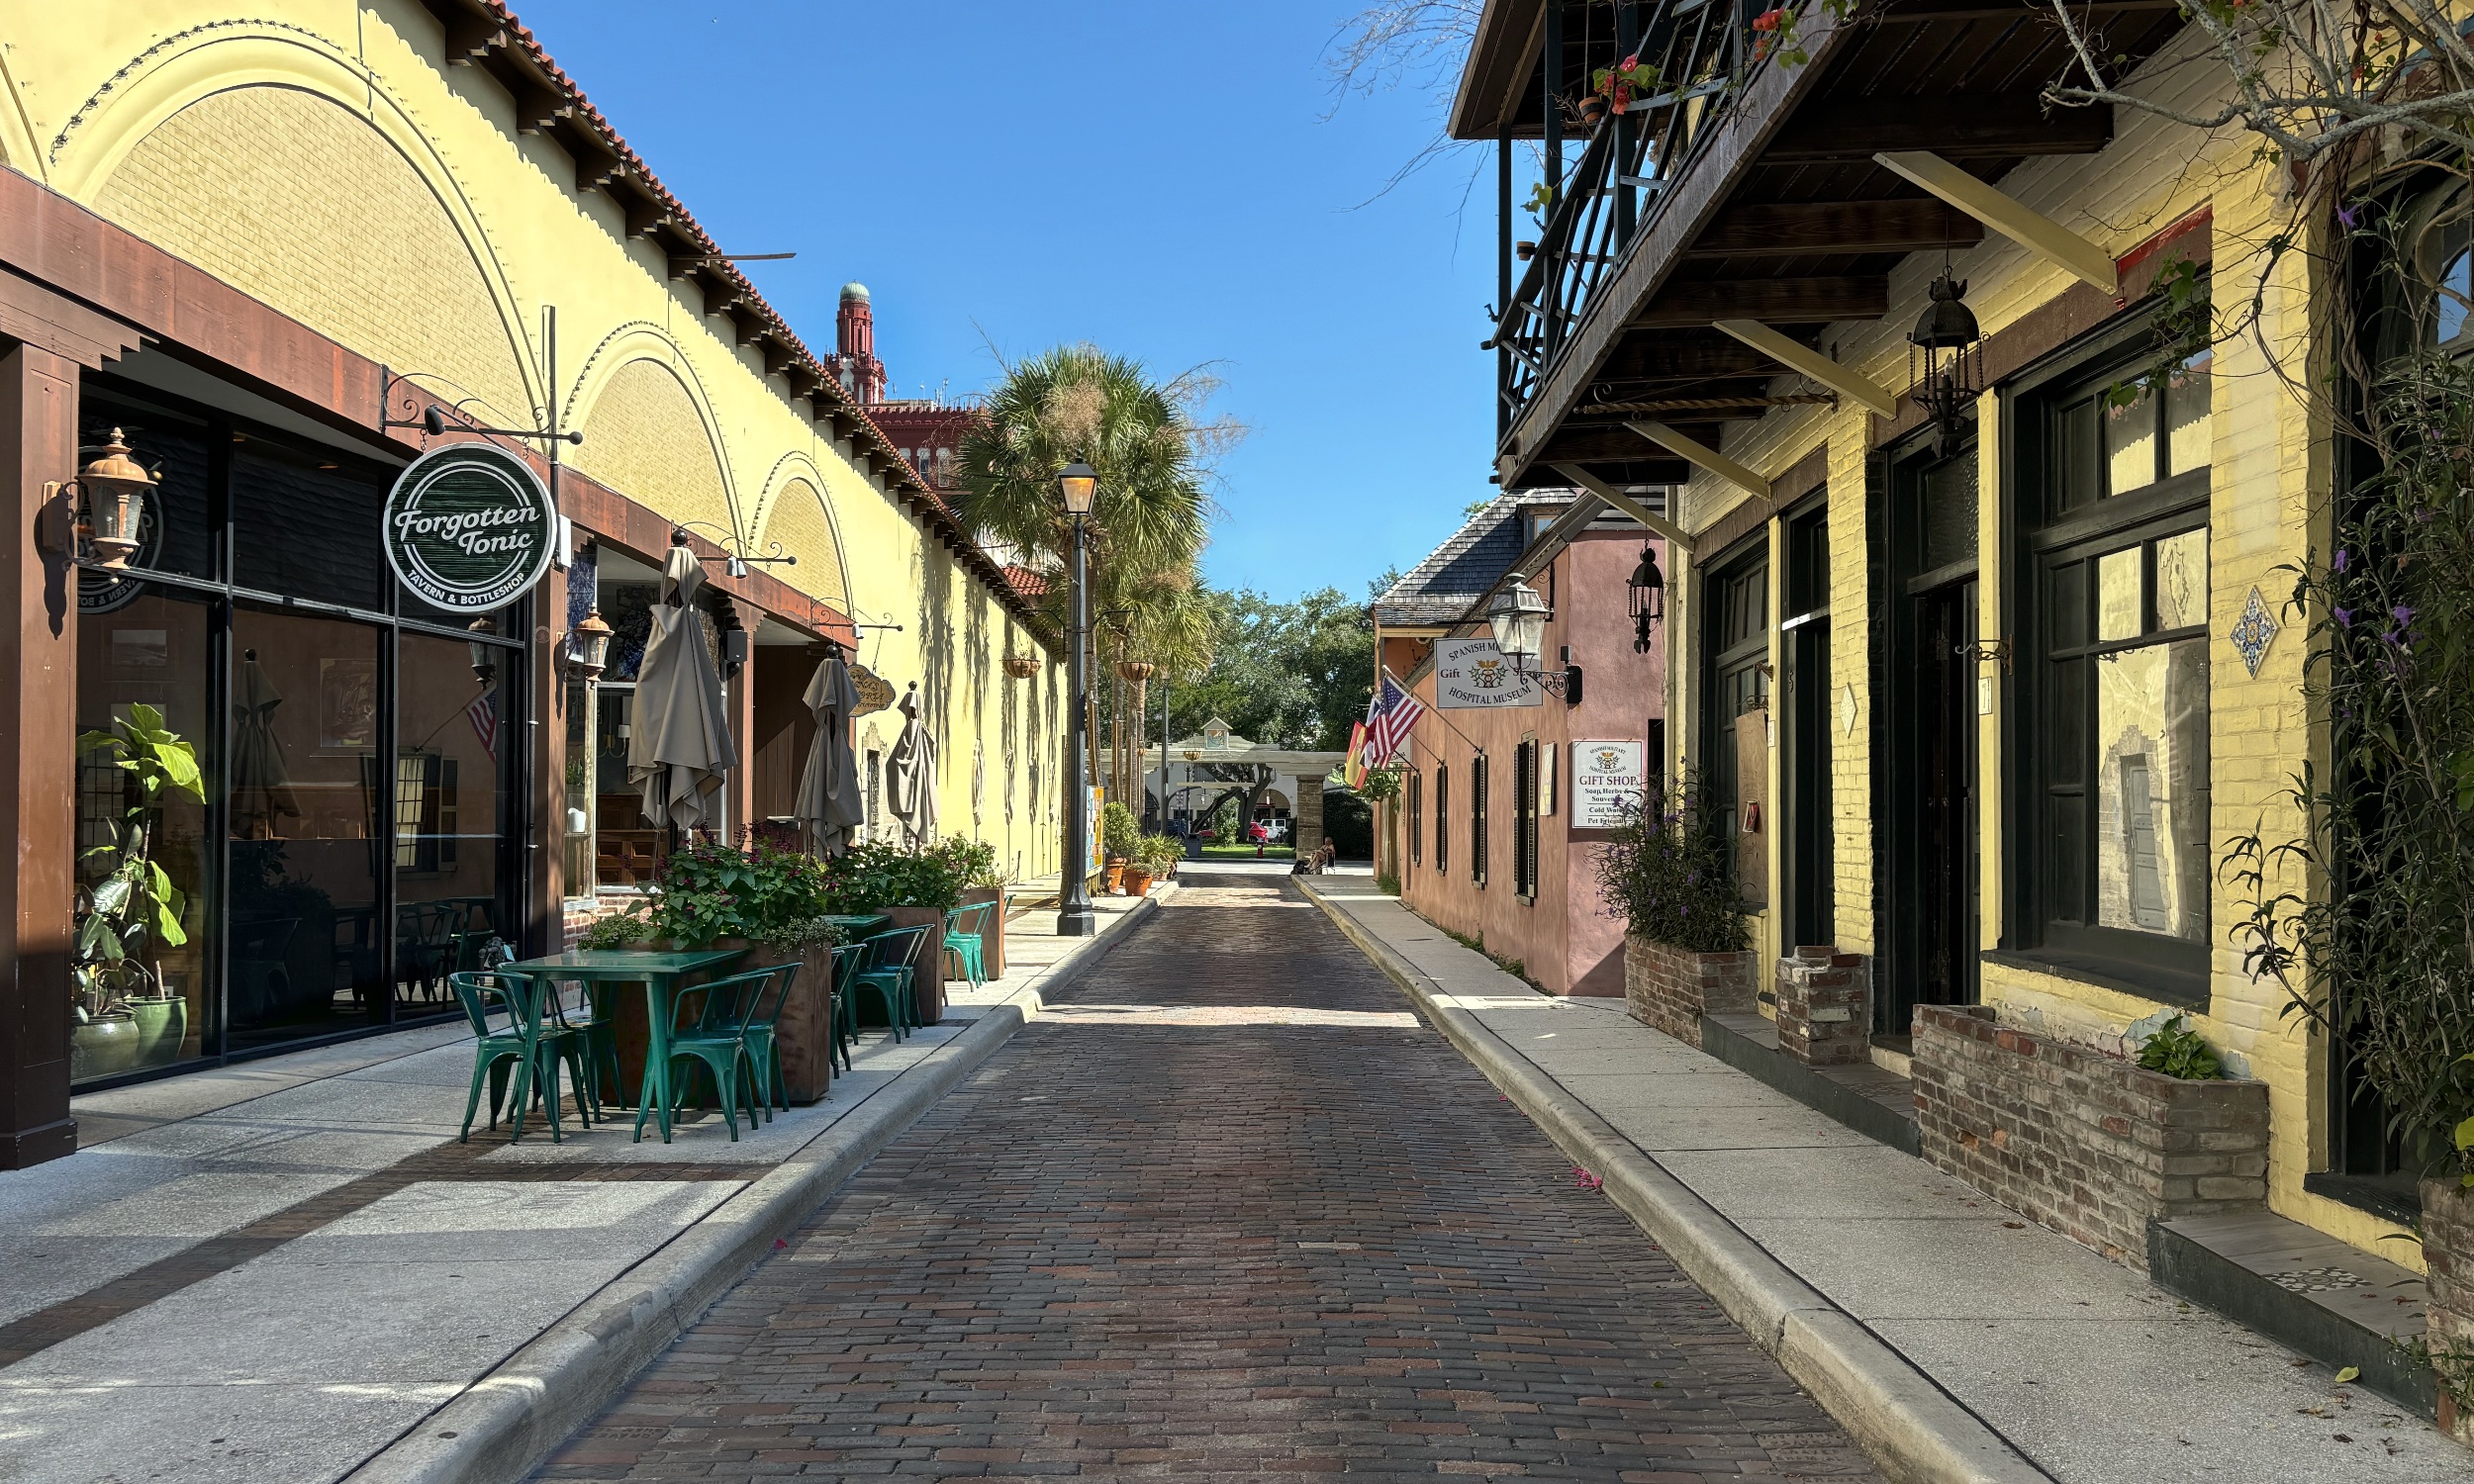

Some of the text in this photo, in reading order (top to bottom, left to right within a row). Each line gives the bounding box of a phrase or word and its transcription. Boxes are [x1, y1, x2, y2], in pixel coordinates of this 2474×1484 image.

[395, 507, 540, 542] Forgotten
[458, 527, 534, 556] Tonic
[407, 570, 525, 604] TAVERN & BOTTLESHOP
[1448, 642, 1485, 662] SPANISH
[1440, 668, 1461, 679] Gift
[1448, 685, 1532, 704] HOSPITAL MUSEUM
[1588, 766, 1608, 775] HOSPITAL
[1579, 776, 1637, 786] GIFT SHOP
